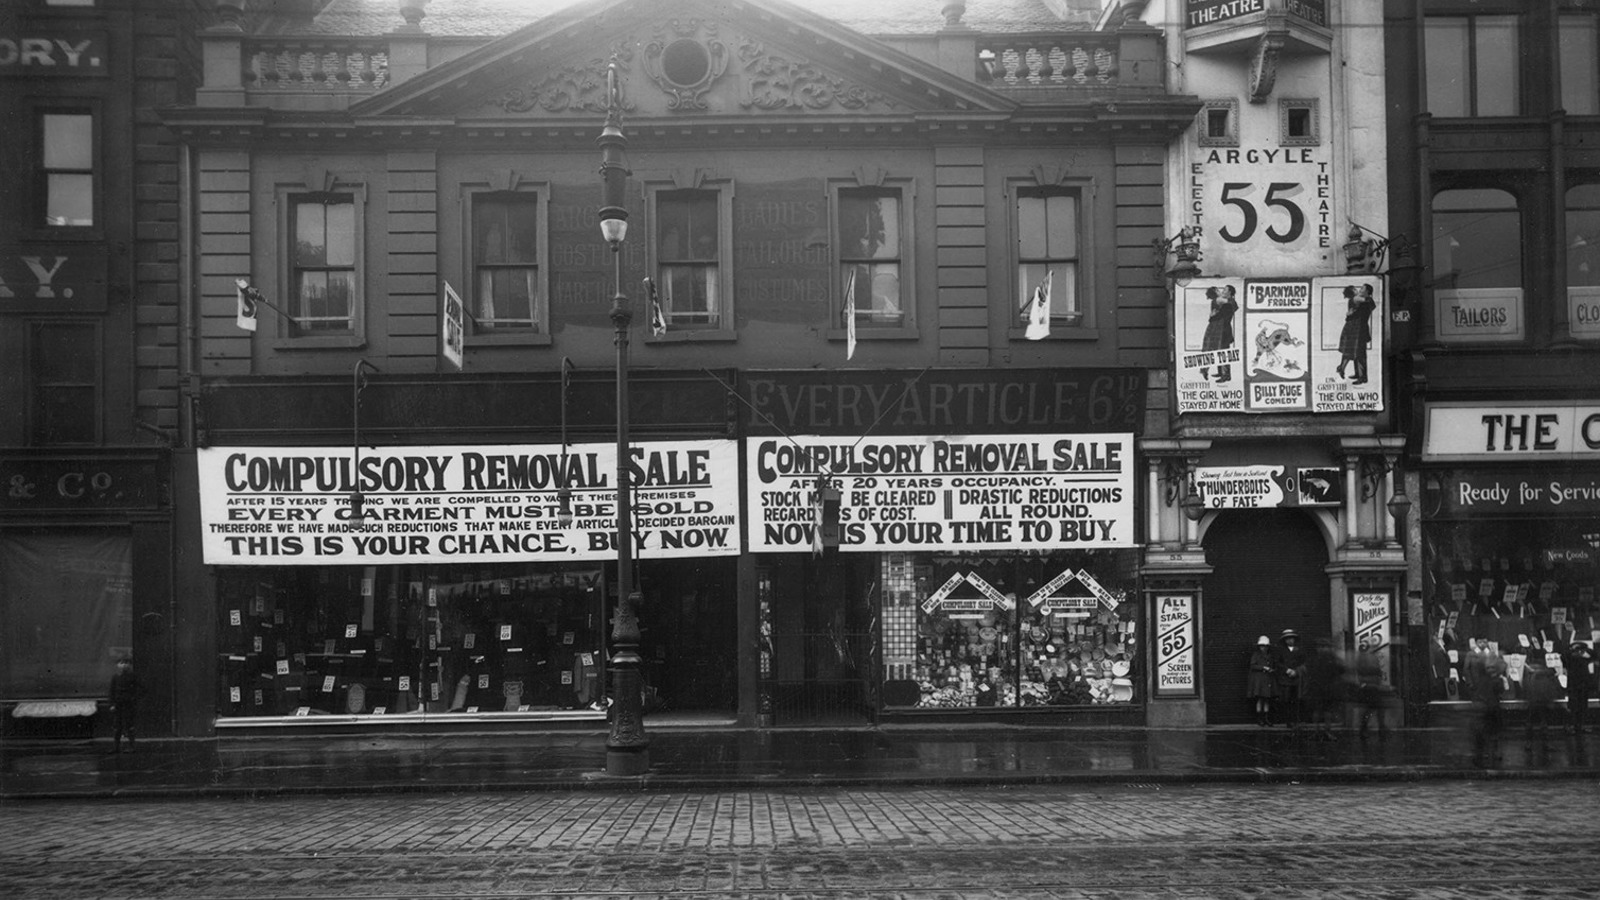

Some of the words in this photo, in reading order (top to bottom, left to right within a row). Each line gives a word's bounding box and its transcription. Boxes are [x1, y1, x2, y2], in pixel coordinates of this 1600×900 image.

[1189, 0, 1262, 25] THEATRE
[1206, 148, 1313, 164] ARGYLE
[1218, 182, 1309, 244] 55
[1452, 305, 1507, 327] TAILORS
[746, 378, 896, 428] EVERY
[899, 374, 1079, 427] ARTICLE
[1200, 390, 1219, 400] GIRL
[1221, 389, 1243, 399] WHO
[1254, 385, 1277, 402] BILLY
[1279, 384, 1302, 397] RUGE
[1265, 397, 1297, 405] COMEDY
[1336, 392, 1356, 401] GIRL
[1357, 391, 1379, 401] WHO
[1180, 401, 1208, 410] STAYED
[1209, 401, 1218, 409] AT
[1316, 402, 1345, 410] STAYED
[1346, 402, 1355, 410] AT
[1481, 414, 1559, 451] THE
[224, 452, 454, 492] COMPULSORY
[461, 451, 608, 490] REMOVAL
[627, 447, 711, 488] SALE
[757, 440, 927, 484] COMPULSORY
[932, 440, 1048, 473] REMOVAL
[1052, 439, 1122, 471] SALE
[8, 474, 36, 498] &
[852, 477, 877, 489] 20
[886, 478, 943, 489] YEARS
[951, 476, 1056, 487] OCCUPANCY.
[1197, 479, 1271, 502] THUNDERBOLTS
[227, 497, 265, 506] AFTER
[271, 497, 285, 506] 15
[288, 497, 327, 506] YEARS
[334, 497, 384, 506] TRING
[391, 497, 409, 506] WE
[415, 497, 441, 506] ARE
[448, 495, 521, 505] COMPELLED
[525, 495, 542, 503] TO
[544, 494, 584, 503] VACTE
[589, 494, 618, 502] THES
[636, 491, 697, 500] PREMISES
[761, 491, 801, 507] STOCK
[851, 491, 870, 507] BE
[874, 490, 936, 506] CLEARED
[959, 489, 1022, 505] DRASTIC
[1029, 487, 1122, 504] REDUCTIONS
[1459, 482, 1510, 505] Ready
[1519, 482, 1543, 505] for
[228, 508, 323, 521] EVERY
[486, 504, 561, 519] MUST
[574, 503, 616, 517] BE
[632, 501, 714, 516] SOLD
[1212, 497, 1228, 508] OF
[764, 507, 851, 522] REGARDS
[858, 507, 876, 521] OF
[880, 507, 917, 521] COST.
[980, 505, 1012, 520] ALL
[1021, 504, 1092, 519] ROUND.
[210, 523, 273, 534] THEREFORE
[277, 523, 294, 533] WE
[299, 523, 324, 533] HAVE
[328, 523, 355, 533] MAD
[387, 522, 458, 533] REDUCTIONS
[466, 521, 495, 532] THAT
[500, 521, 531, 531] MAKE
[638, 517, 685, 528] DECIDED
[688, 515, 735, 526] BARGAIN
[839, 523, 866, 545] IS
[871, 522, 944, 545] YOUR
[949, 521, 1012, 543] TIME
[1018, 520, 1053, 542] TO
[1059, 519, 1117, 542] BUY.
[224, 536, 304, 556] THIS
[314, 536, 344, 556] IS
[351, 535, 430, 555] YOUR
[438, 532, 577, 554] CHANCE,
[660, 527, 728, 549] NOW.
[1548, 551, 1563, 561] New
[1162, 597, 1187, 613] ALL
[1161, 612, 1189, 622] STARS
[1162, 627, 1186, 656] 55
[1167, 663, 1192, 672] SCREEN
[1161, 674, 1192, 686] PICTURES
